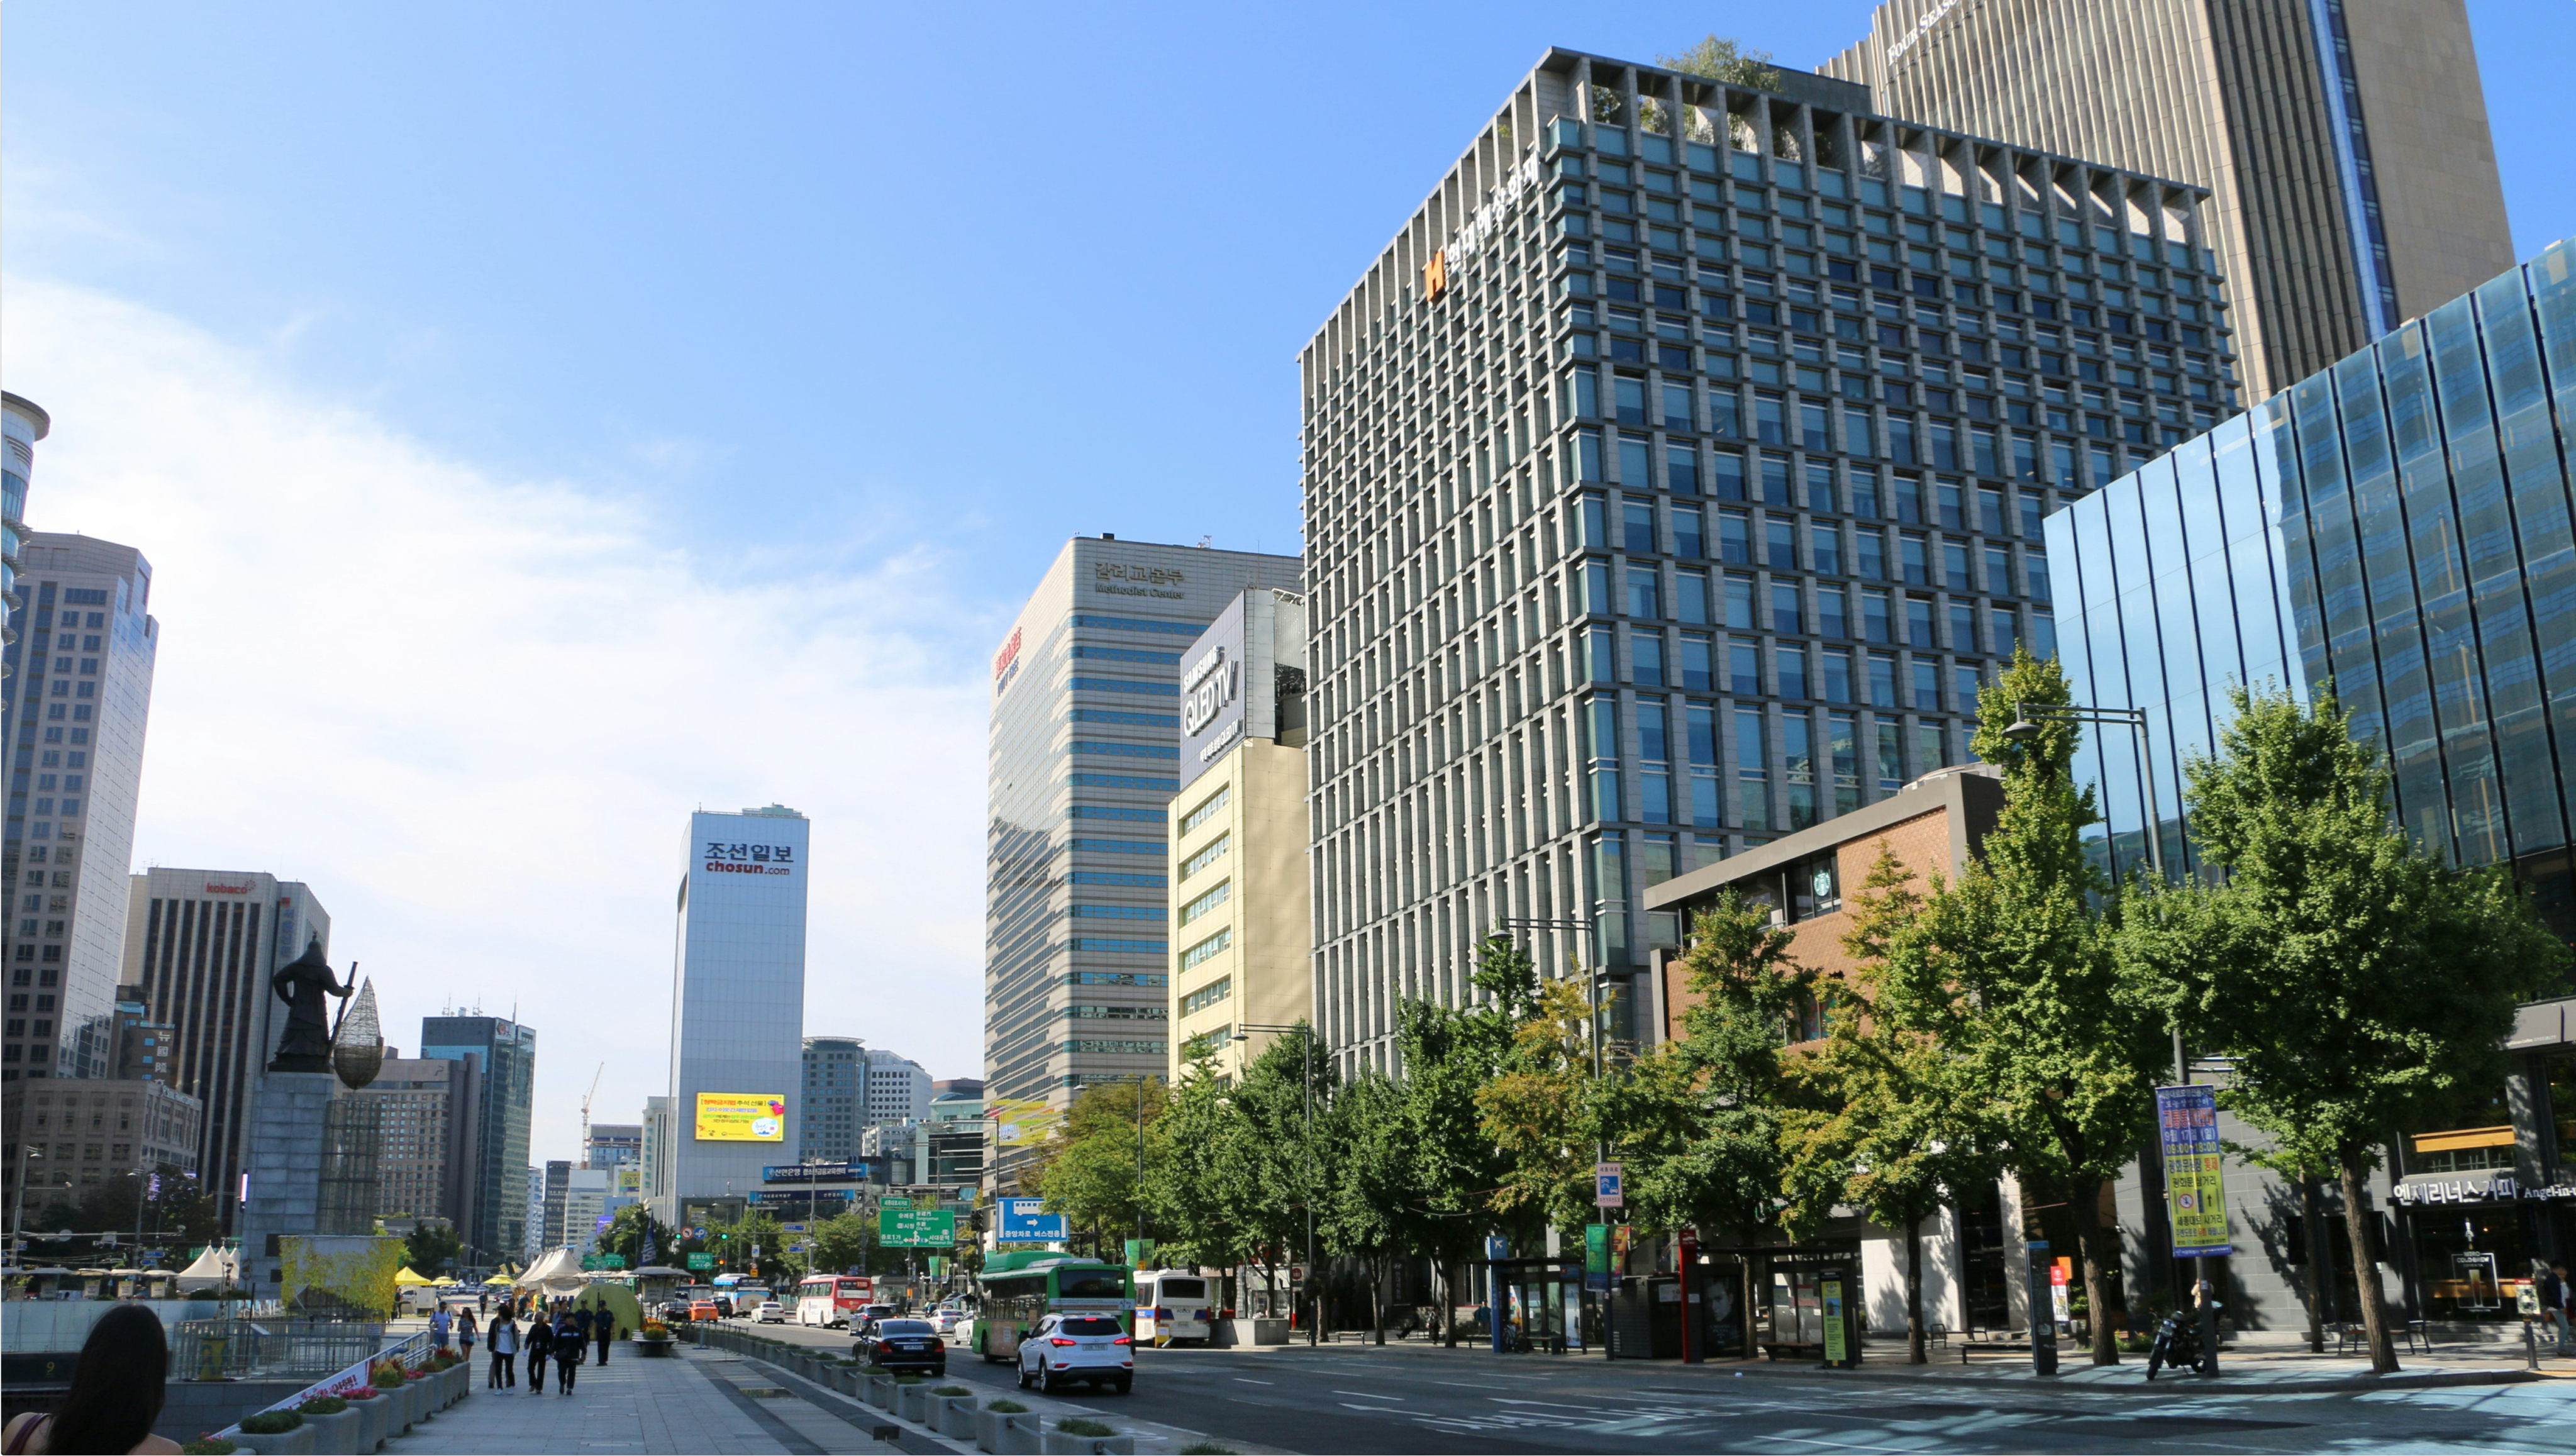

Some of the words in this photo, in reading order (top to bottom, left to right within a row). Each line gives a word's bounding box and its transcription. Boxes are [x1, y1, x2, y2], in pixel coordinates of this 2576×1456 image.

[1887, 28, 1919, 67] FOUR
[1447, 150, 1541, 274] 현대해상화재
[1096, 562, 1184, 586] 감리교본부
[1096, 583, 1148, 597] Methodist
[1150, 588, 1185, 599] Center
[1184, 645, 1221, 694] SAMSUNG
[1184, 681, 1218, 737] QLED
[1216, 660, 1236, 708] TV
[1220, 725, 1232, 746] QLED
[1231, 718, 1238, 736] TV
[704, 843, 794, 862] 조선일보
[706, 860, 790, 875] chosun.com
[206, 883, 247, 894] kobaco
[2165, 1130, 2178, 1142] 9월
[2181, 1128, 2197, 1141] 17일
[2201, 1127, 2216, 1140] (일)
[775, 1167, 801, 1176] 신한은행
[2168, 1158, 2202, 1174] 광화문광장
[2204, 1157, 2219, 1172] 통제
[2172, 1177, 2194, 1188] 광화문
[2196, 1175, 2217, 1187] 삼거리
[2393, 1177, 2518, 1206] 엔제리너스커피
[2177, 1216, 2201, 1226] 세종대로
[2204, 1214, 2223, 1225] 사거리
[47, 1362, 55, 1372] 9
